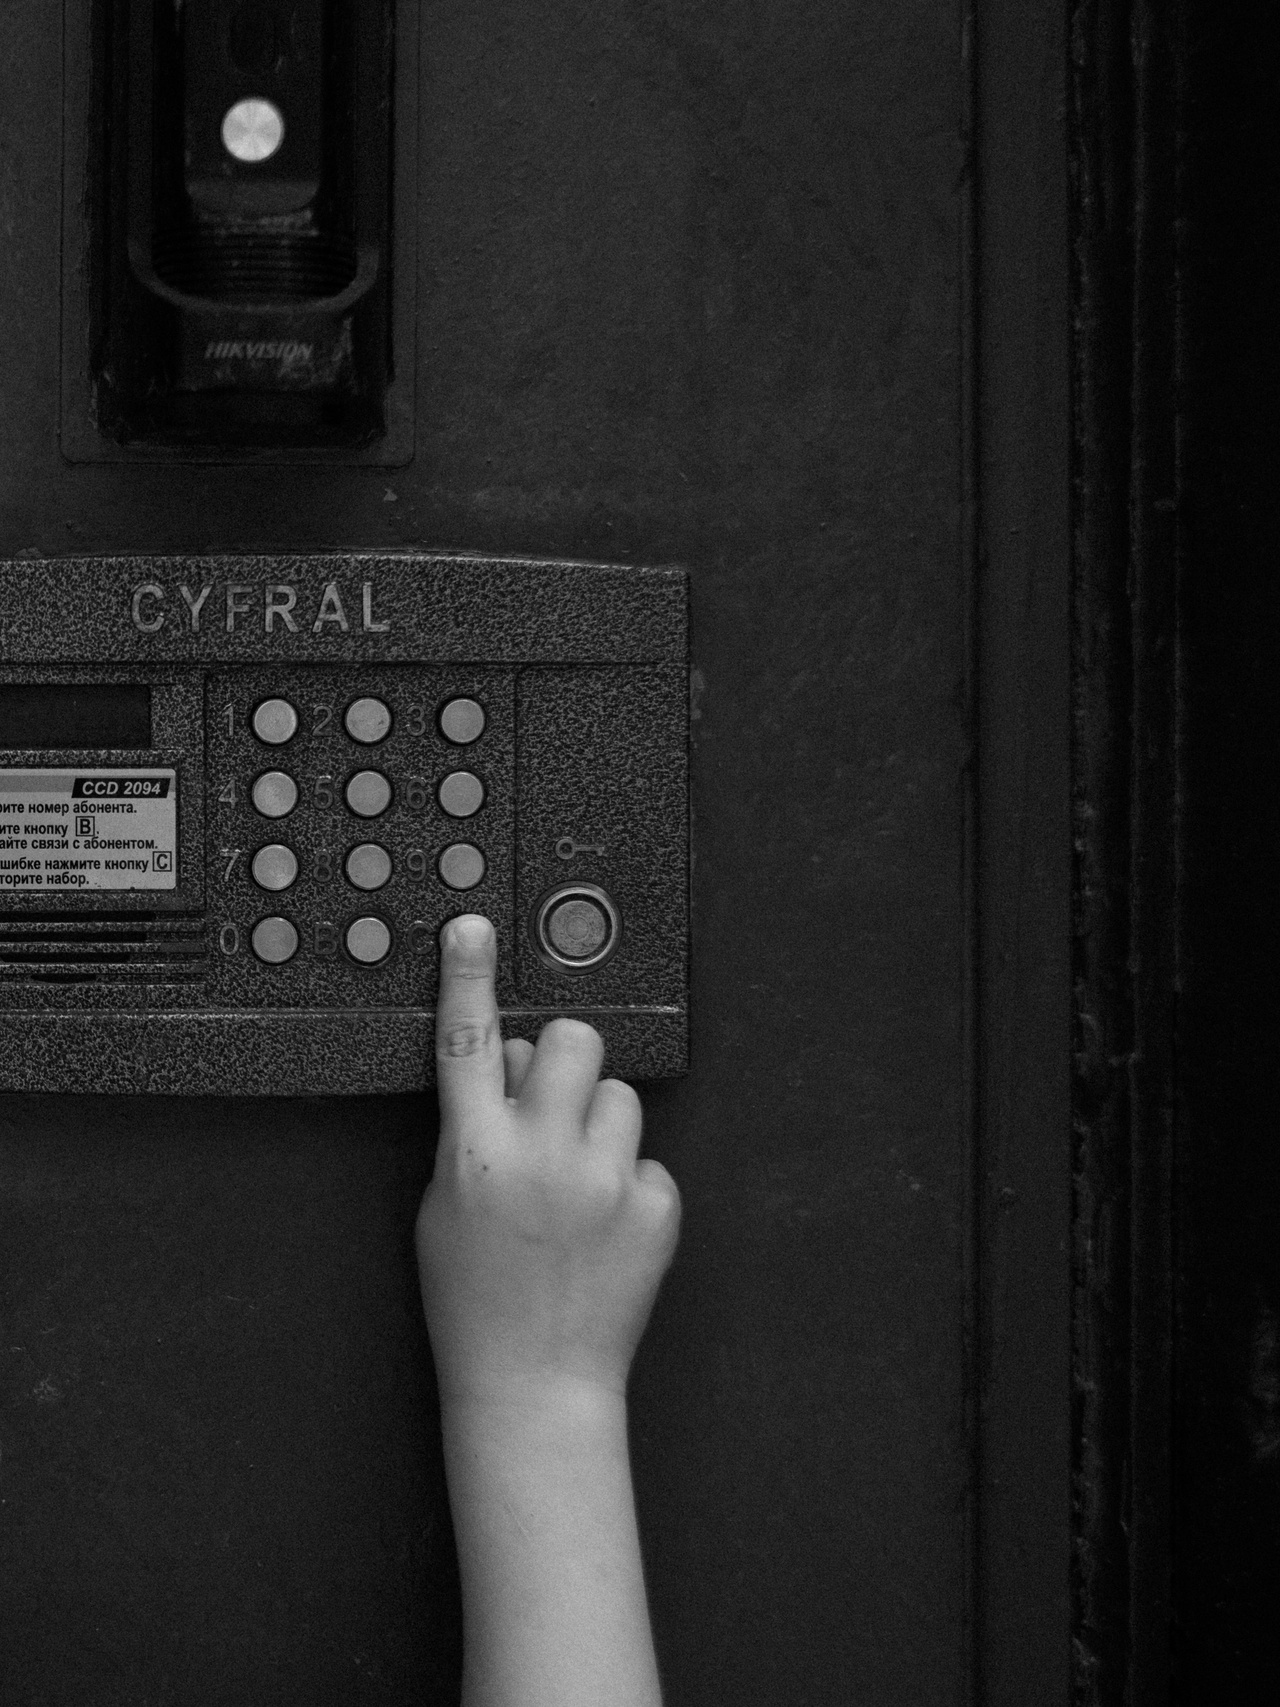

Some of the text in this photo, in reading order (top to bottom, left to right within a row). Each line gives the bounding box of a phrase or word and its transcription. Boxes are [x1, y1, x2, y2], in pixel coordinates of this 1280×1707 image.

[204, 341, 314, 359] HIKVISION
[131, 582, 391, 633] CYFRAL
[220, 702, 427, 738] 1 2 3
[81, 781, 161, 795] CCD 2094
[218, 775, 427, 810] 4 5 6
[28, 804, 70, 816] номер
[73, 801, 137, 814] абонента.
[24, 824, 68, 837] кнопку
[31, 838, 69, 849] связи
[84, 836, 158, 849] абонентом.
[45, 859, 101, 870] нажмите
[105, 859, 149, 872] кнопку
[220, 849, 427, 883] 7 8 9
[47, 872, 90, 887] набор.
